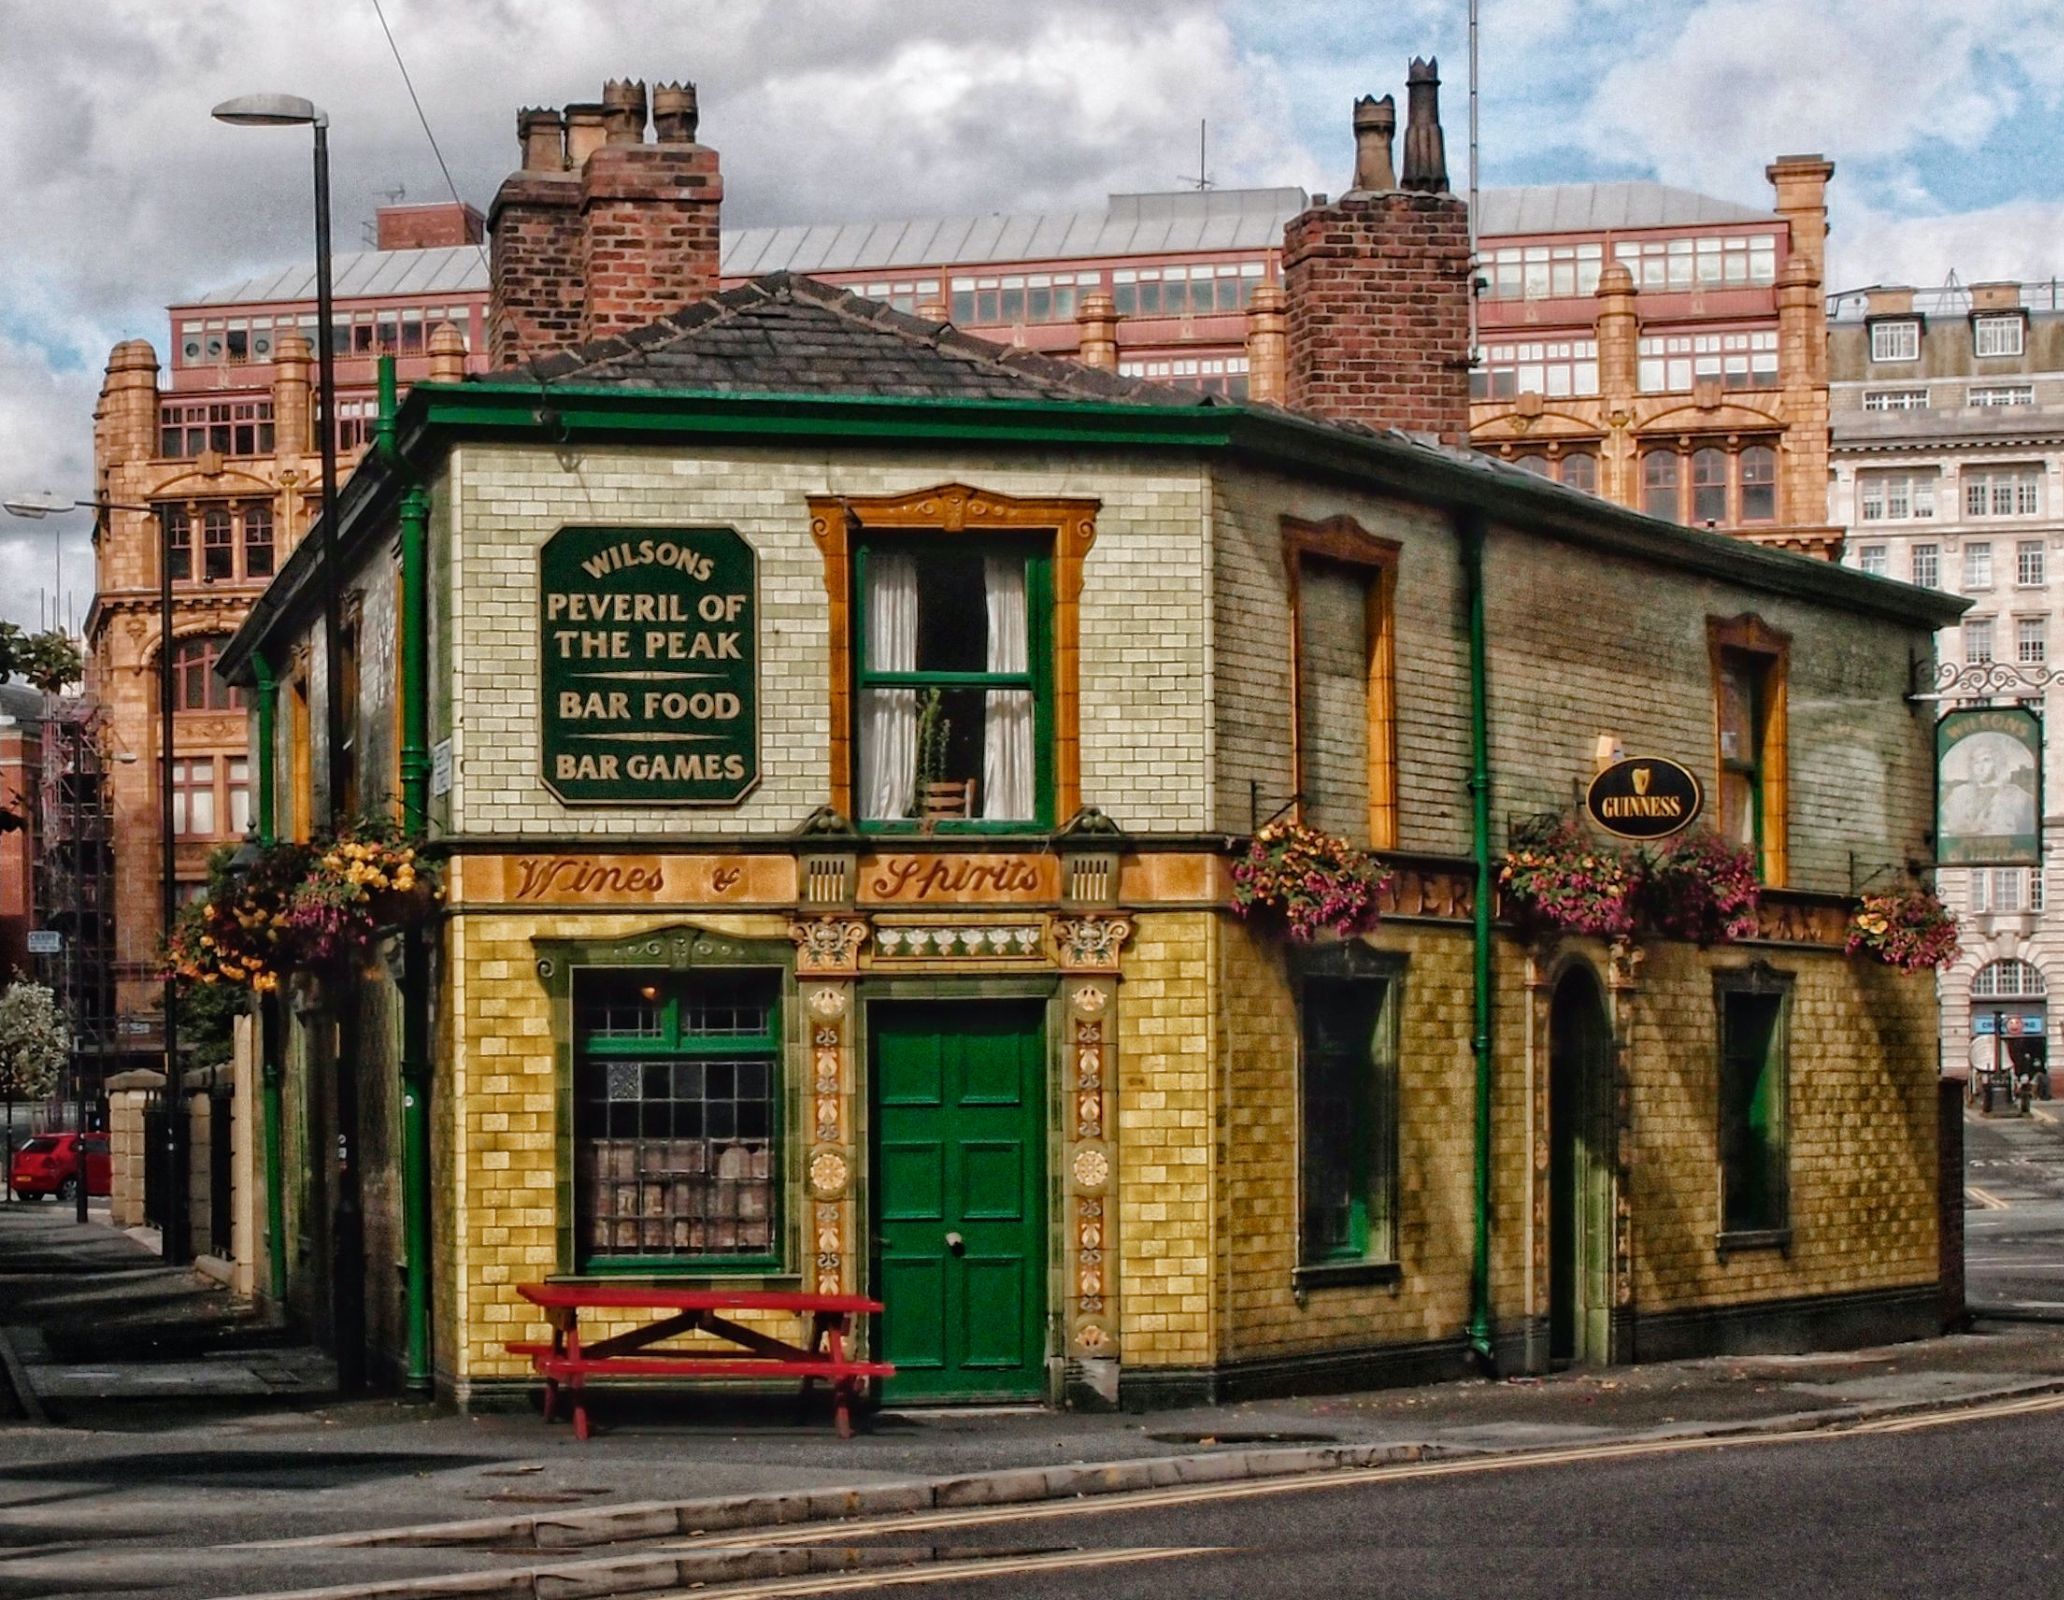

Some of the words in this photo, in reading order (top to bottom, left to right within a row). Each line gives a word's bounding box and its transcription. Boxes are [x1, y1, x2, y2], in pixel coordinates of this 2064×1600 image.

[581, 539, 715, 582] WILSONS
[547, 592, 689, 622] PEVERIL
[698, 593, 747, 622] OF
[553, 630, 632, 659] THE
[645, 630, 743, 660] PEAK
[559, 690, 632, 720] BAR
[644, 691, 741, 720] FOOD
[1946, 713, 2029, 739] WILSONS
[556, 753, 621, 780] BAR
[626, 753, 746, 780] GAMES
[1601, 795, 1682, 818] GUINNESS
[516, 858, 665, 899] Wines
[712, 866, 741, 892] &
[872, 858, 1038, 899] Spirits
